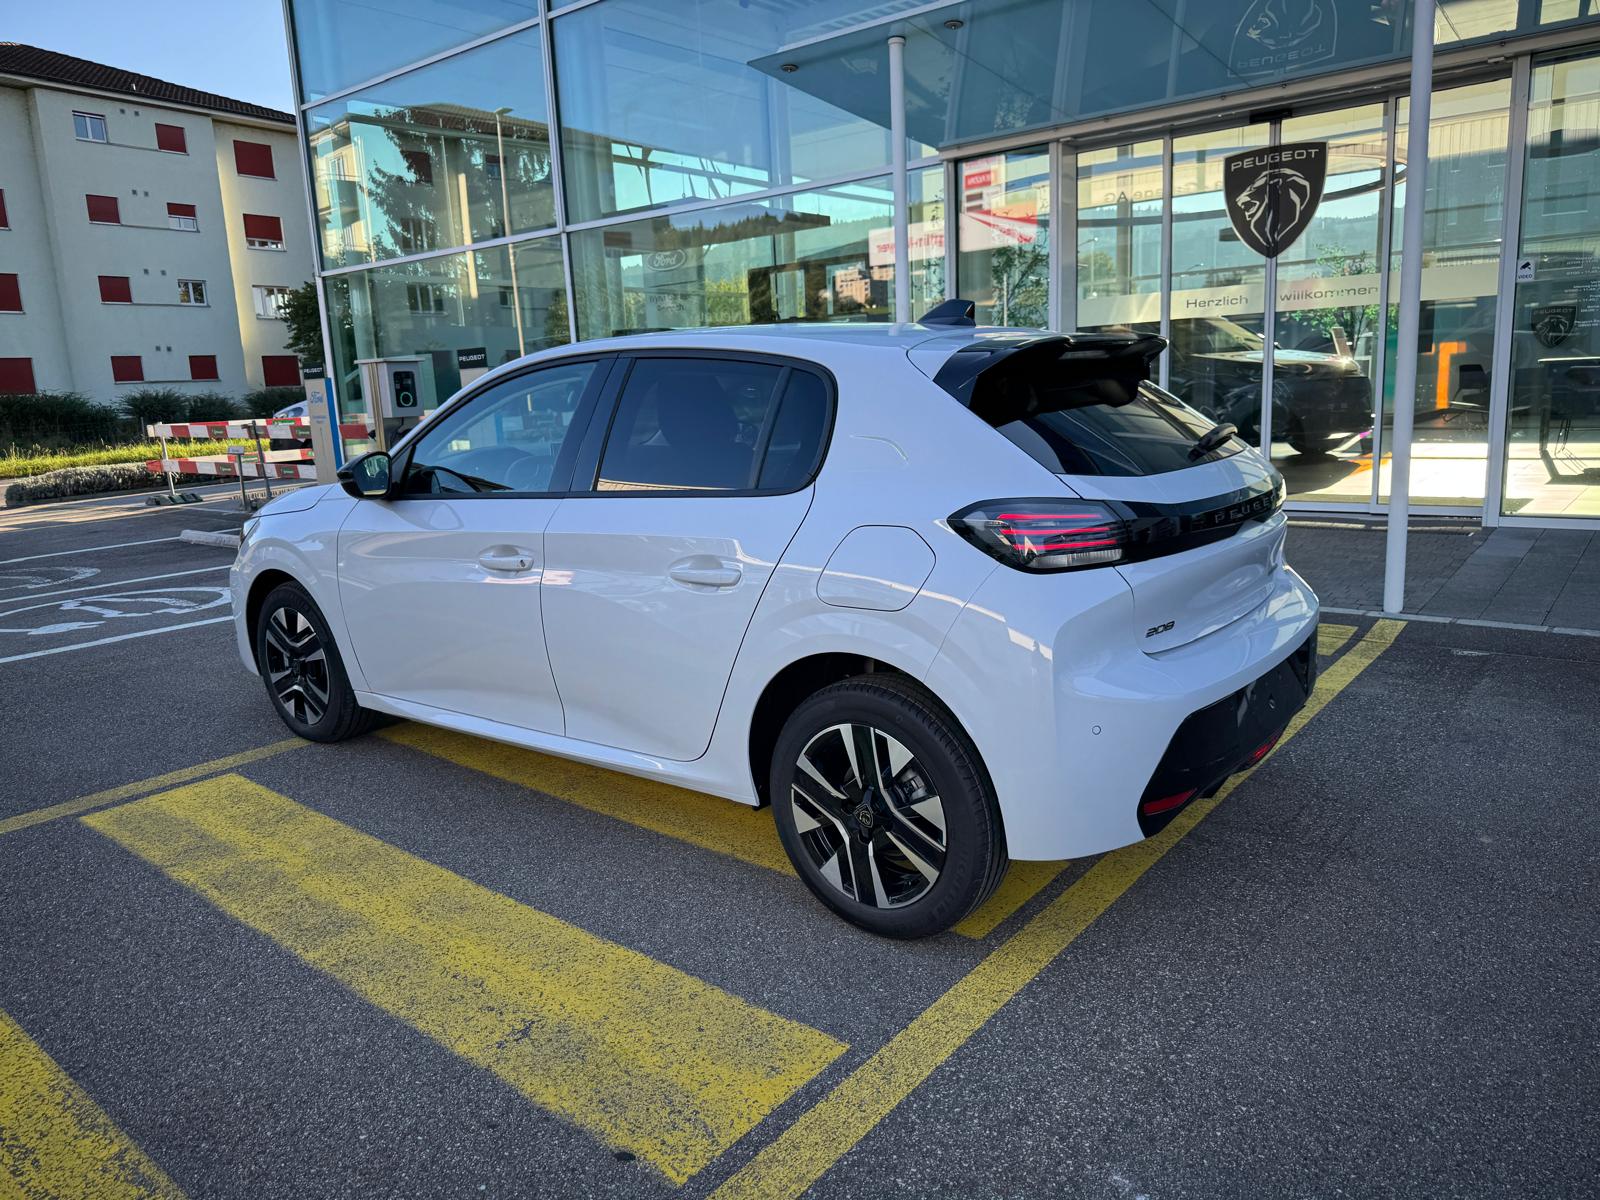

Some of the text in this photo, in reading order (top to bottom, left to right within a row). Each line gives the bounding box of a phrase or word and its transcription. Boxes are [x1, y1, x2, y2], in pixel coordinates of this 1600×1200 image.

[1230, 148, 1320, 173] PEUGEOT
[1186, 286, 1379, 309] Herzlich willkommen
[1533, 307, 1574, 316] PEUGEOT
[458, 353, 486, 363] PEUGEOT
[303, 366, 323, 374] PEUGEOT
[1214, 491, 1275, 524] PEUGE
[1145, 620, 1176, 639] 208
